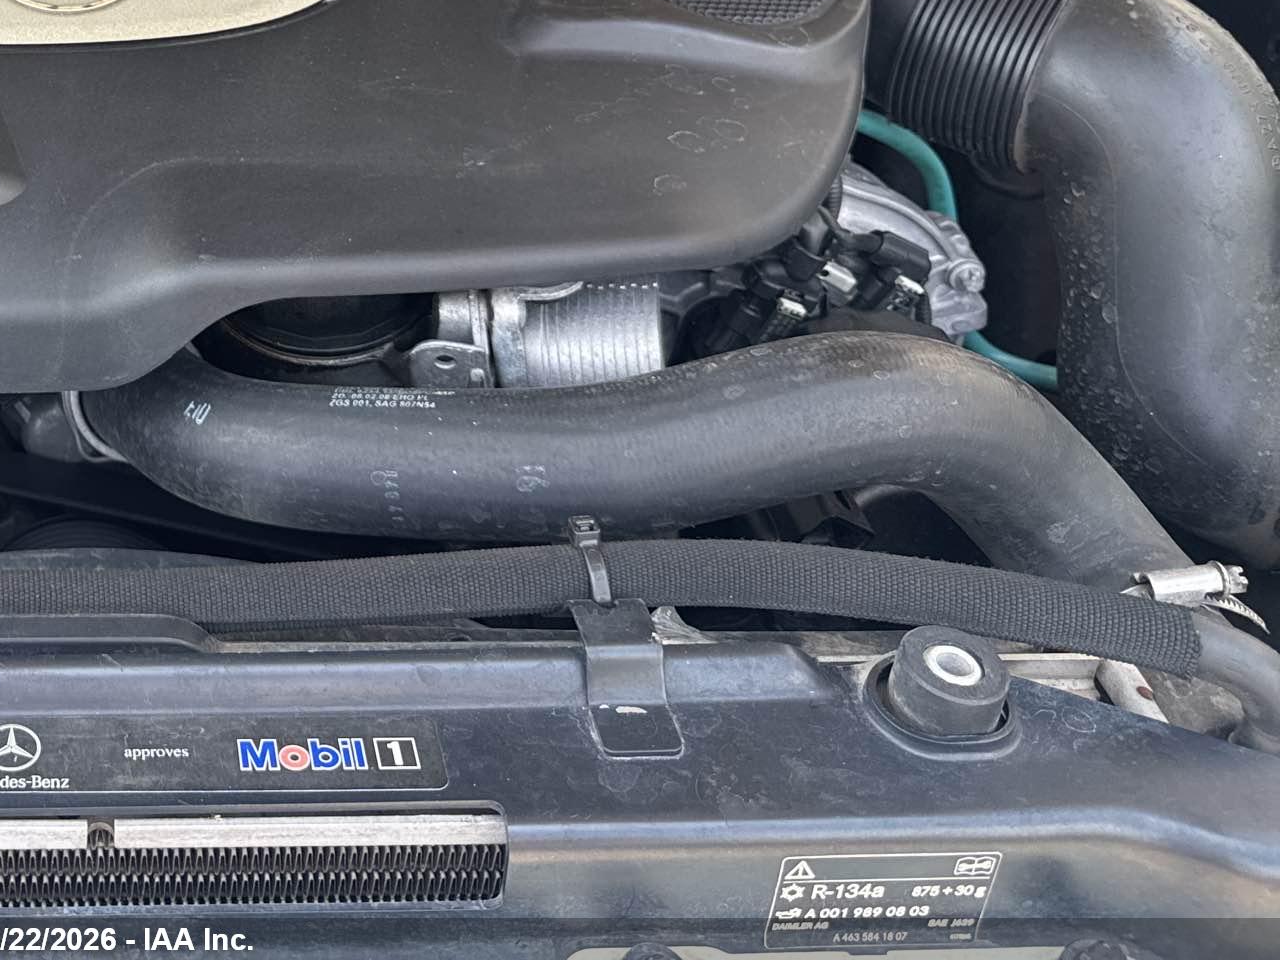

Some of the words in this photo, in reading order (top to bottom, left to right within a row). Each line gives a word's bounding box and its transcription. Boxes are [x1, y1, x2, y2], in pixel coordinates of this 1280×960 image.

[124, 746, 190, 761] approves
[236, 738, 369, 771] Mobil
[811, 884, 885, 900] R-134a
[804, 908, 817, 919] A
[819, 907, 848, 919] 001
[853, 906, 880, 918] 989
[885, 906, 906, 918] 08
[909, 905, 930, 917] 03
[771, 921, 815, 931] DAIMLER
[814, 921, 830, 930] AG
[841, 933, 860, 942] 463
[895, 932, 908, 941] 07
